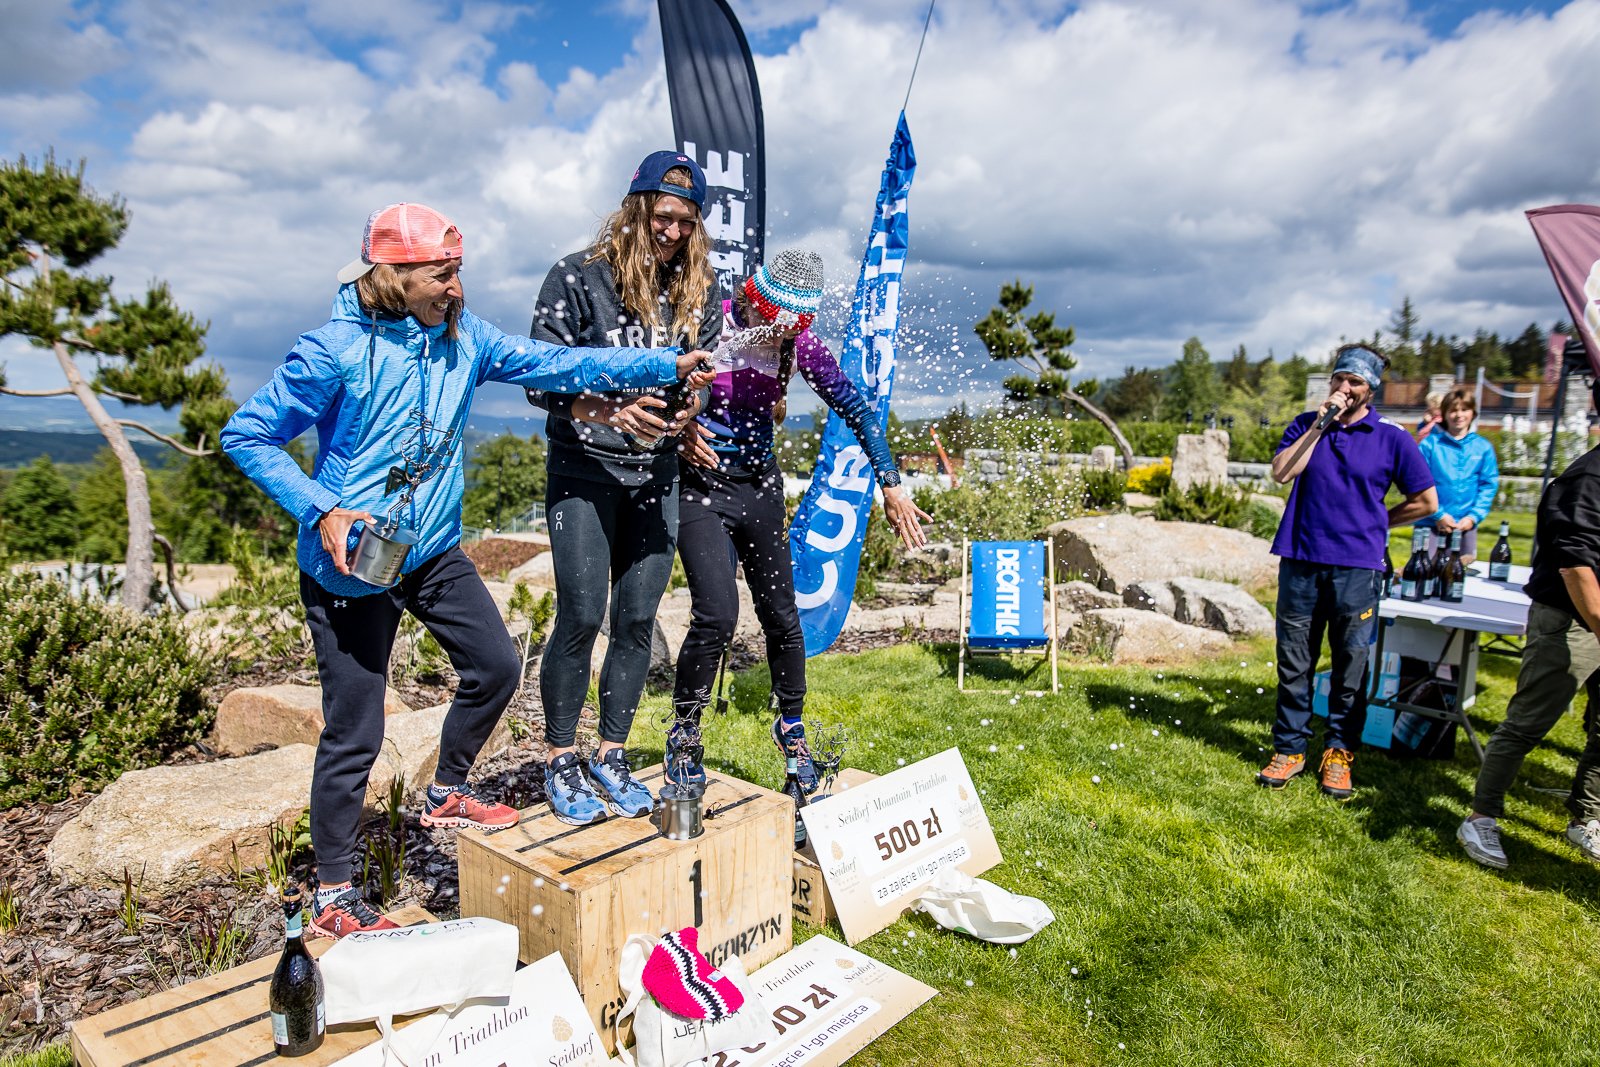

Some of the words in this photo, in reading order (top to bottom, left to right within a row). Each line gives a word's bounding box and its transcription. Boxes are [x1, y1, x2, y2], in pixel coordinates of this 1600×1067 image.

[837, 802, 870, 828] Seidorf
[873, 788, 912, 812] Mountain
[912, 773, 948, 795] Triathlon
[874, 820, 921, 861] 500
[922, 807, 943, 839] zł
[828, 856, 857, 880] Seidorf
[877, 887, 889, 899] za
[938, 846, 967, 866] miejsca
[689, 859, 703, 929] 1
[762, 960, 815, 991] Triathlon
[843, 960, 877, 983] Seidorf
[801, 983, 838, 1010] zł
[449, 1005, 529, 1055] Triathlon
[827, 1005, 869, 1034] miejsca
[548, 1032, 594, 1067] Seidorf
